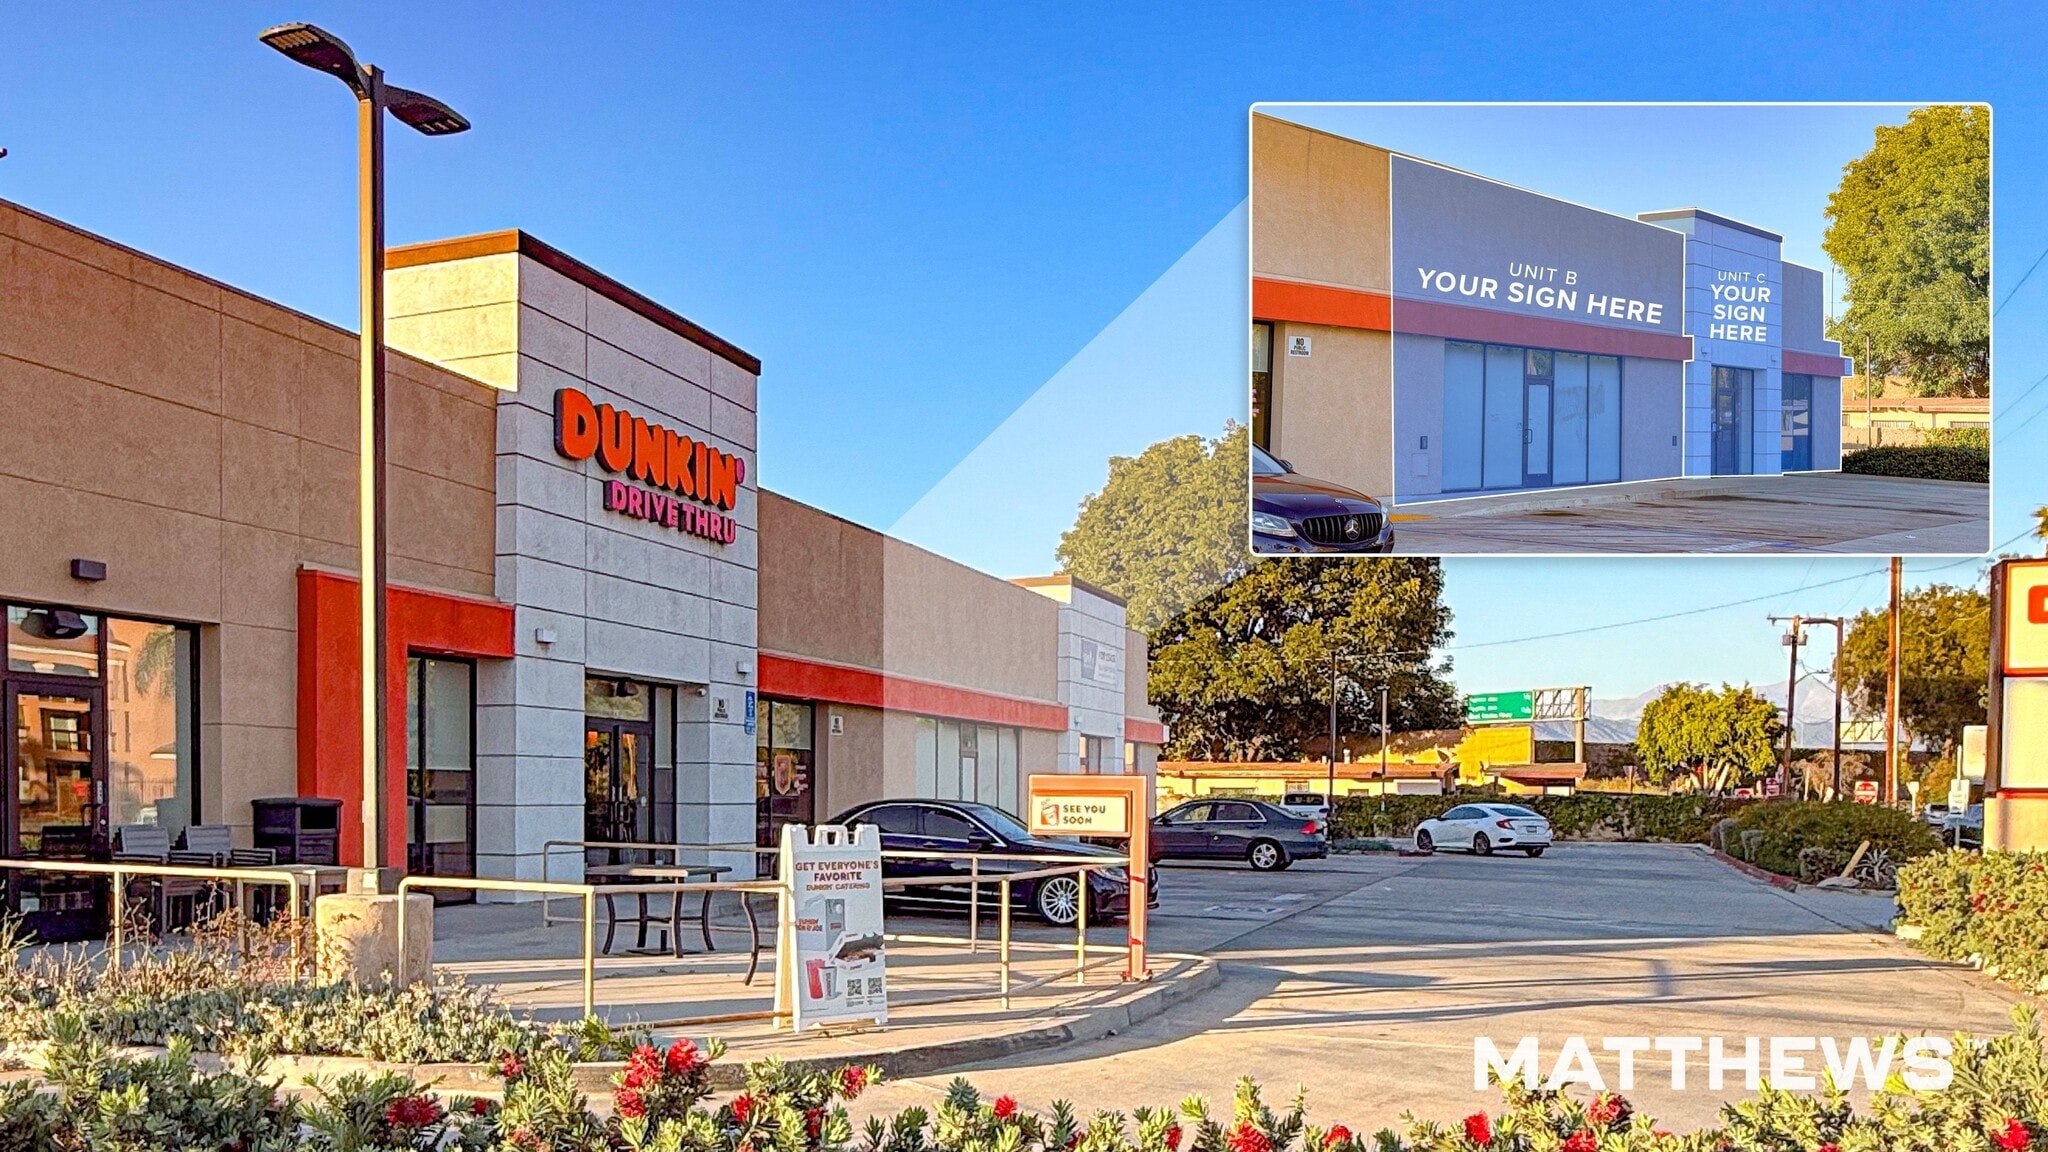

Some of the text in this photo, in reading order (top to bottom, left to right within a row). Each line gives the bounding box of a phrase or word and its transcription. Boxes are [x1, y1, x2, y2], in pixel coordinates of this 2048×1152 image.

[1296, 338, 1304, 346] NO
[554, 387, 745, 511] DUNKIN'
[604, 480, 735, 545] DRIVE THRU
[1063, 804, 1106, 814] SEE YOU
[1063, 816, 1092, 824] SOON
[795, 861, 879, 871] GET EVERYONE'S
[814, 872, 862, 881] FAVORITE
